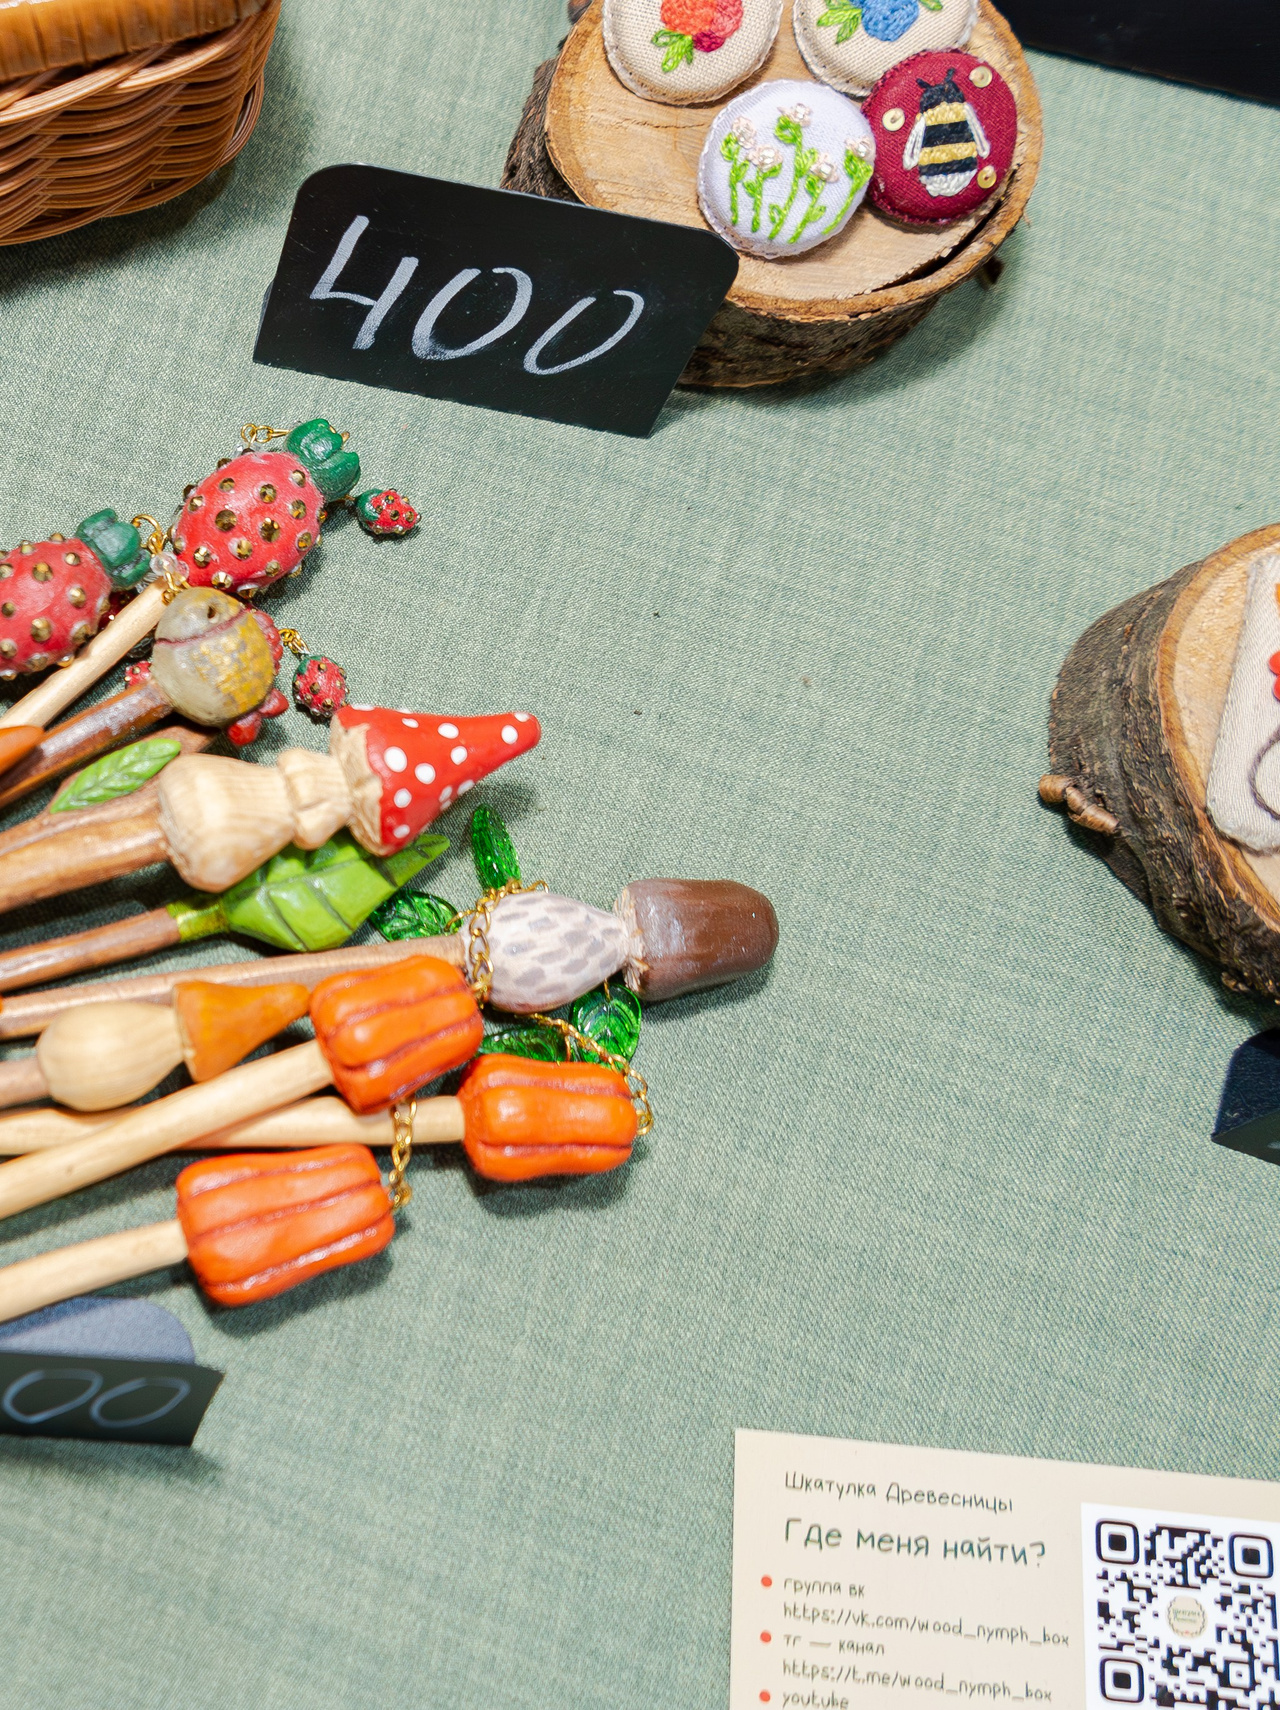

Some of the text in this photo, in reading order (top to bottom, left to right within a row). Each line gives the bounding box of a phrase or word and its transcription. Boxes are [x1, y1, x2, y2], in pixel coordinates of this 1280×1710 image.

[308, 214, 646, 376] 400
[784, 1471, 1014, 1515] Шкатулка Древесницы
[784, 1517, 1047, 1568] Где меня найти?
[783, 1577, 866, 1598] группа вк
[783, 1633, 802, 1648] тг
[837, 1638, 886, 1656] канал
[782, 1690, 850, 1710] youtube
